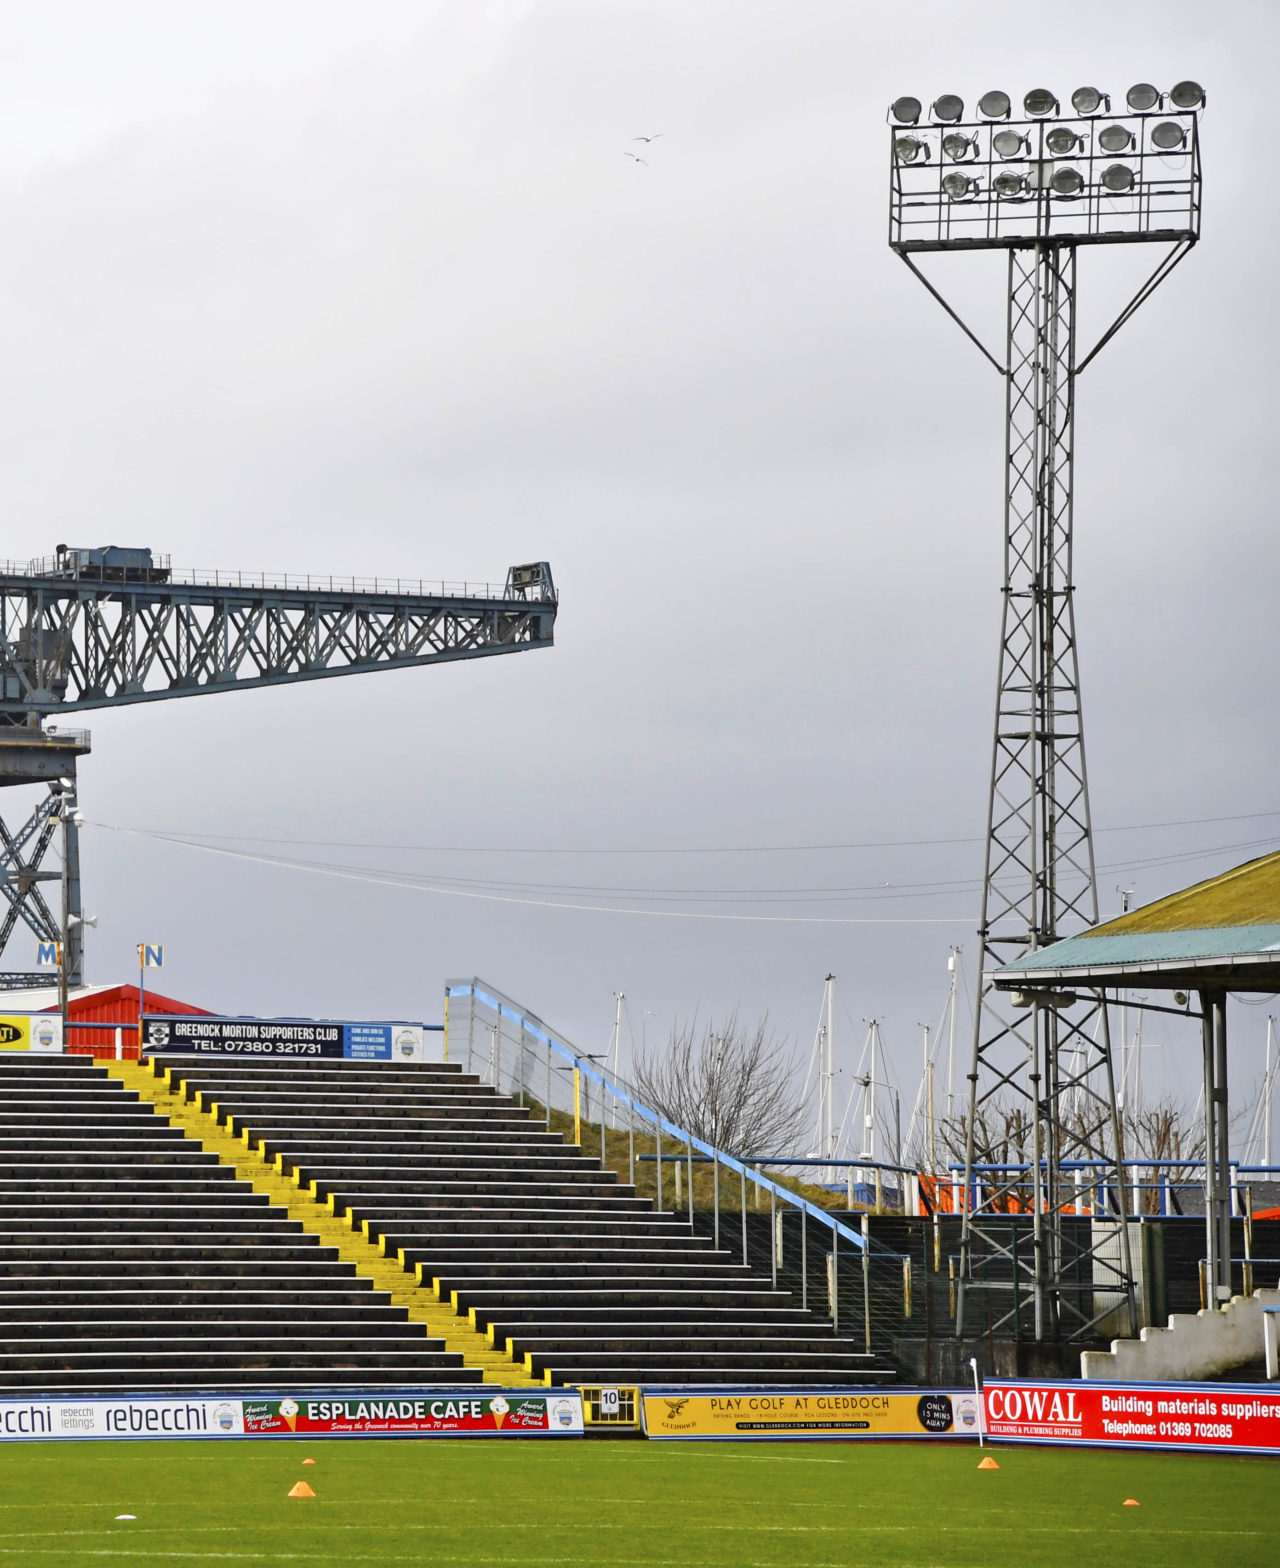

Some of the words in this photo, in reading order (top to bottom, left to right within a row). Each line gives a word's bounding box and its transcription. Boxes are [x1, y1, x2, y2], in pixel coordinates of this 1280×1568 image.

[37, 943, 57, 965] M
[145, 945, 163, 966] N
[175, 1023, 221, 1037] GREENOCK
[222, 1025, 259, 1039] MORTON
[260, 1026, 314, 1040] SUPPORTERS
[316, 1028, 338, 1041] CLUB
[192, 1040, 222, 1051] TEL:
[224, 1041, 273, 1053] 07380
[276, 1043, 322, 1054] 321731
[603, 1392, 617, 1405] 10
[710, 1398, 742, 1410] PLAY
[749, 1397, 785, 1410] GOLF
[794, 1398, 809, 1409] AT
[817, 1397, 889, 1409] GLEDDOCH
[245, 1404, 268, 1414] Award
[308, 1401, 426, 1420] ESPLANADE
[430, 1401, 483, 1419] CAFE
[521, 1400, 544, 1410] Award
[926, 1402, 946, 1411] ONLY
[988, 1389, 1082, 1422] COWAL
[1101, 1395, 1153, 1416] Building
[1157, 1398, 1217, 1415] materials
[1221, 1401, 1280, 1420] suppliers
[61, 1407, 94, 1417] rebecchi
[106, 1404, 207, 1431] rebecchi
[246, 1413, 273, 1423] Winning
[516, 1408, 544, 1420] Winning
[923, 1410, 931, 1418] 15
[933, 1411, 951, 1420] MINS
[61, 1418, 94, 1430] lettings
[247, 1420, 258, 1430] Ice
[260, 1420, 282, 1430] Cream
[331, 1422, 353, 1430] Serving
[354, 1422, 363, 1430] the
[433, 1421, 442, 1429] 70
[509, 1414, 520, 1424] Ice
[521, 1416, 544, 1427] Cream
[925, 1419, 945, 1428] AWAY
[990, 1425, 1018, 1434] BUILDING
[1023, 1426, 1053, 1435] PLUMBING
[1054, 1427, 1082, 1436] SUPPLIES
[1102, 1419, 1157, 1437] Telephone:
[1159, 1421, 1192, 1437] 01369
[1194, 1423, 1233, 1438] 702085
